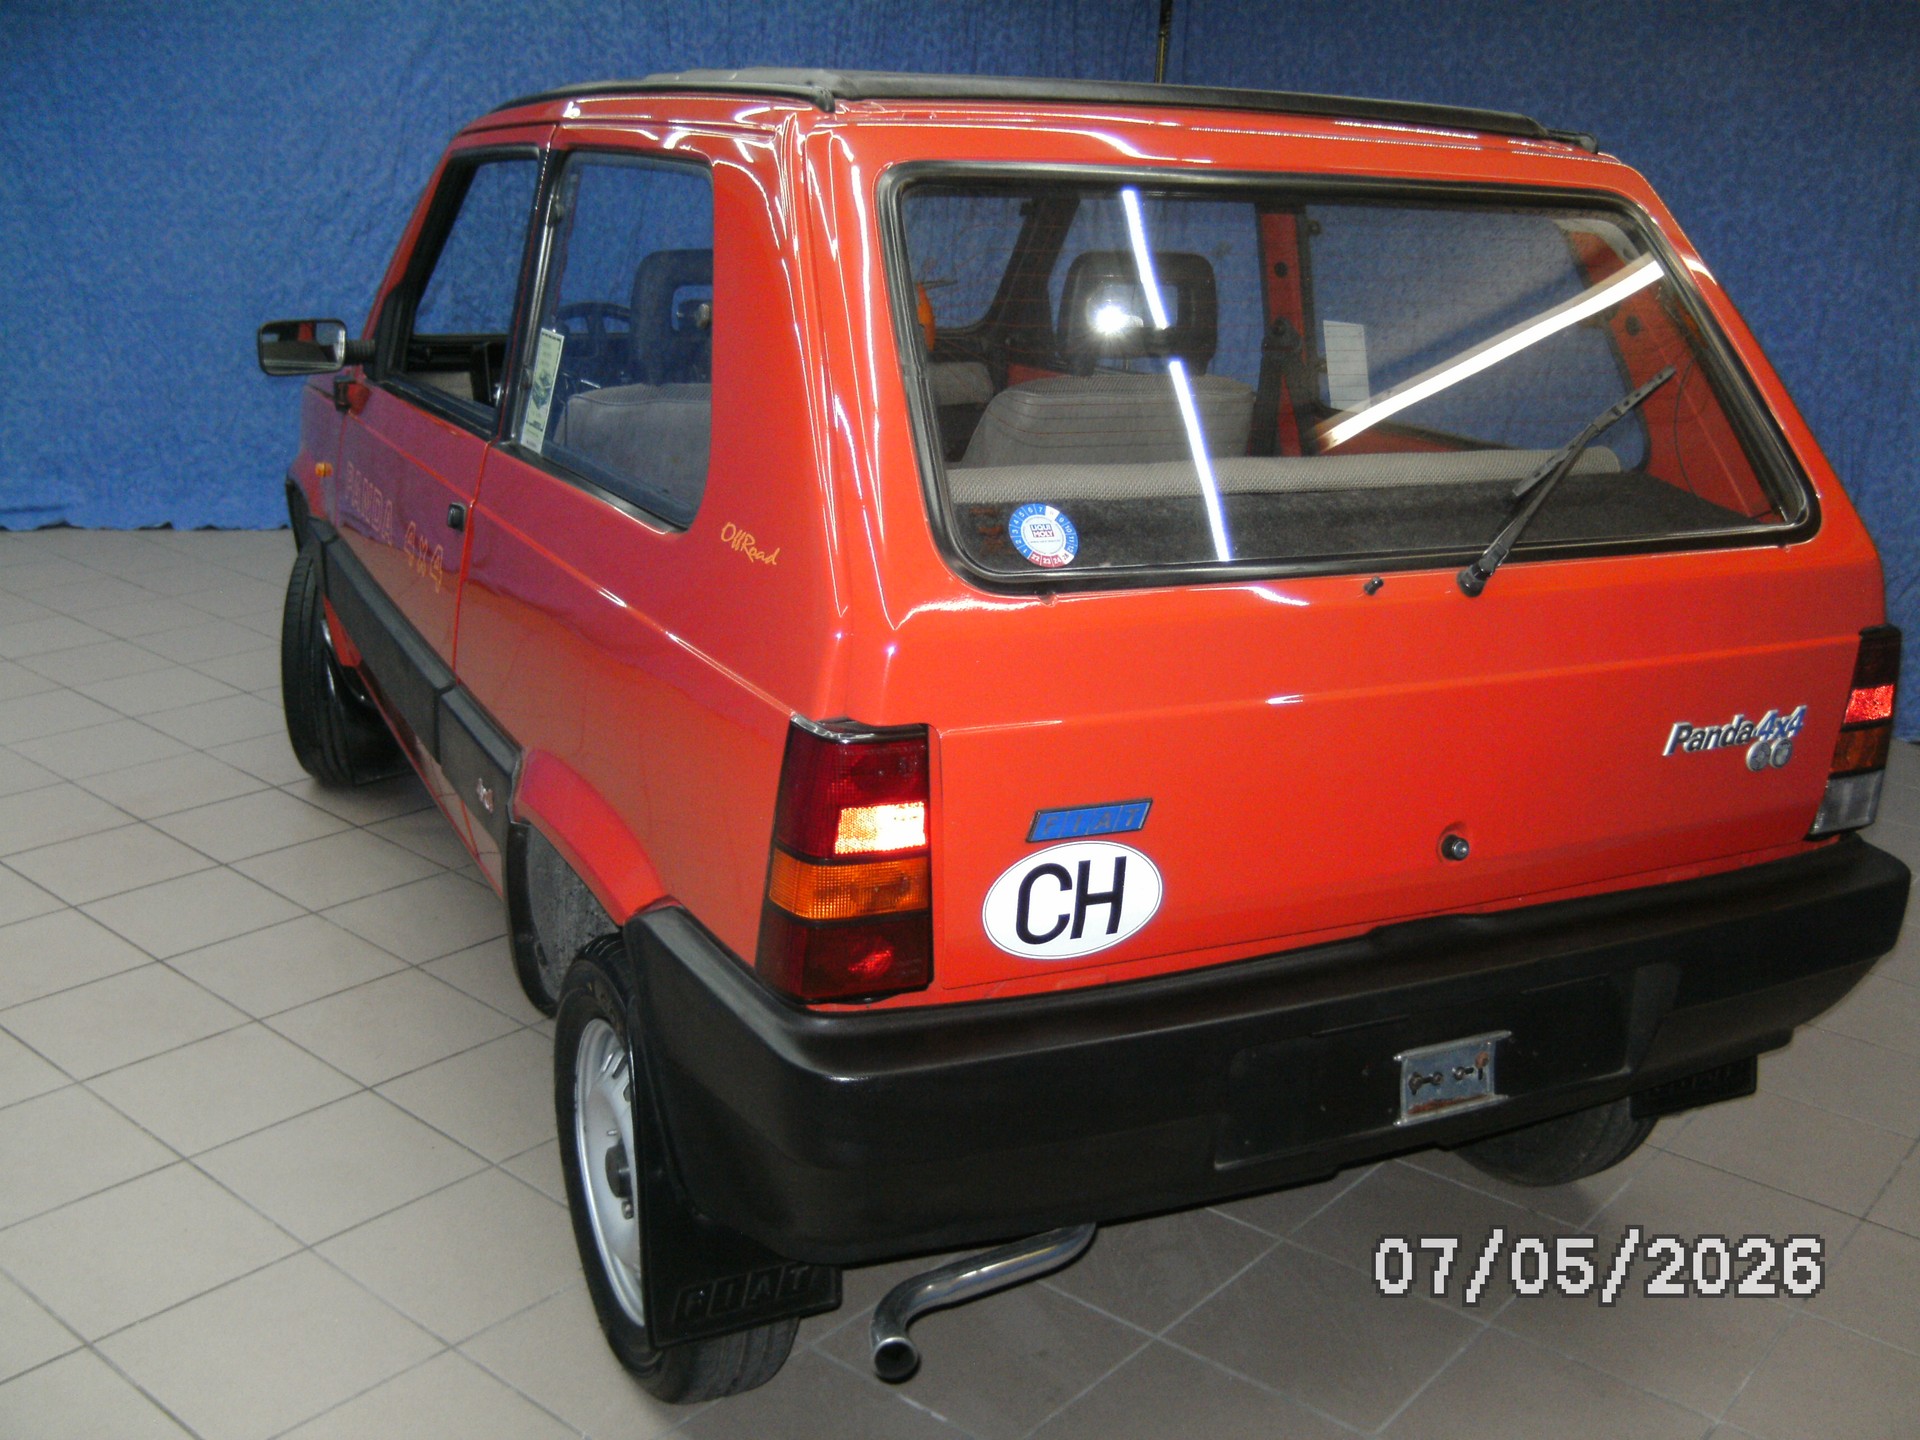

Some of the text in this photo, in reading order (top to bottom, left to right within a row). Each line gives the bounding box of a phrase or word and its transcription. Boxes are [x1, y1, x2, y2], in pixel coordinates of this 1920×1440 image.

[1662, 713, 1755, 757] Panda
[1040, 805, 1143, 838] FIAT
[1015, 856, 1127, 945] CH
